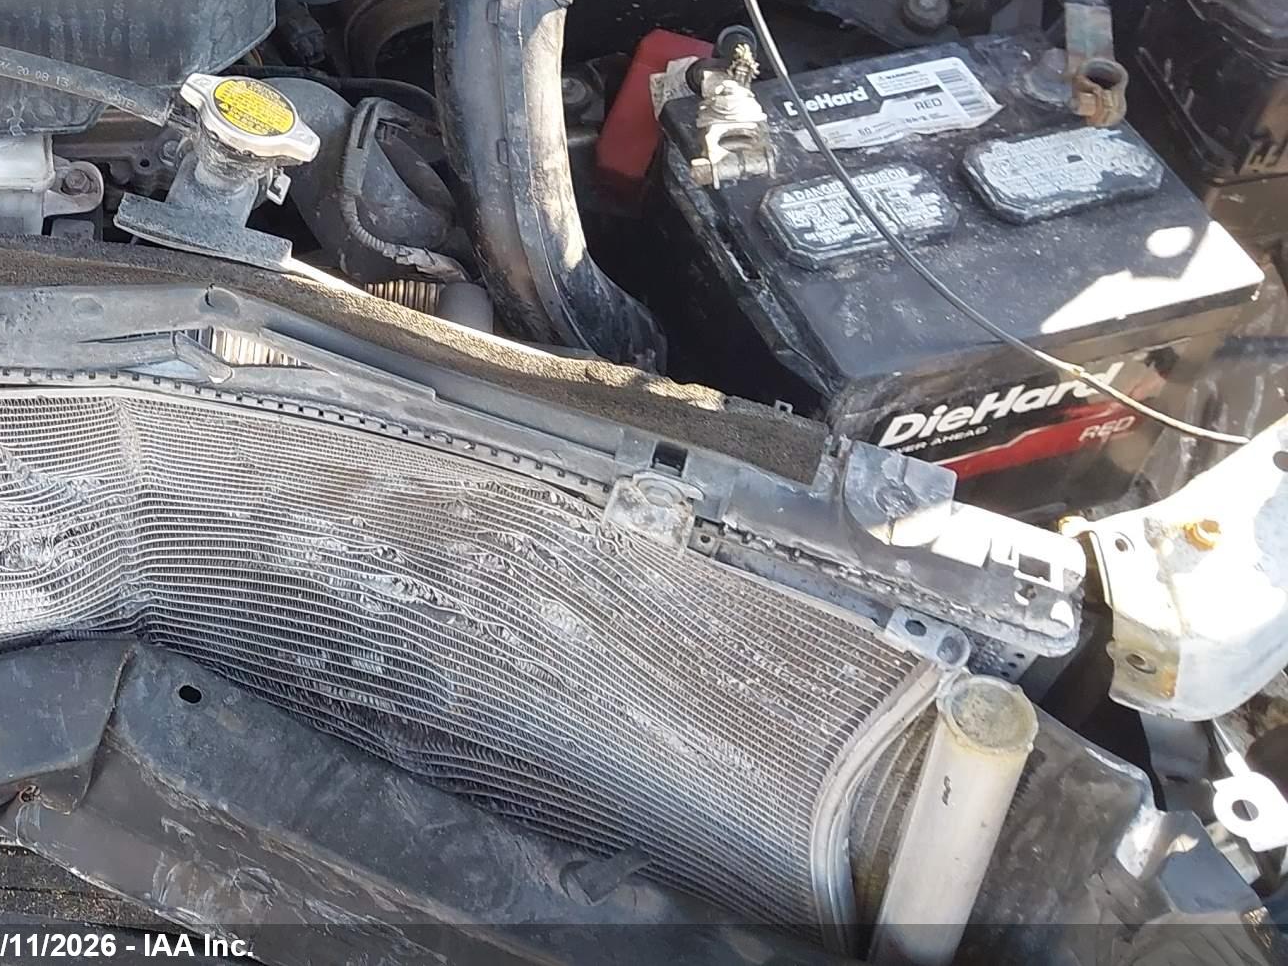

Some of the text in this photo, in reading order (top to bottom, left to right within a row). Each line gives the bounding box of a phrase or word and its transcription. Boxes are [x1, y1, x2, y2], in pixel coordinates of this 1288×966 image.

[914, 97, 943, 111] RED
[879, 362, 1124, 447] DieHard
[1078, 415, 1137, 443] RED
